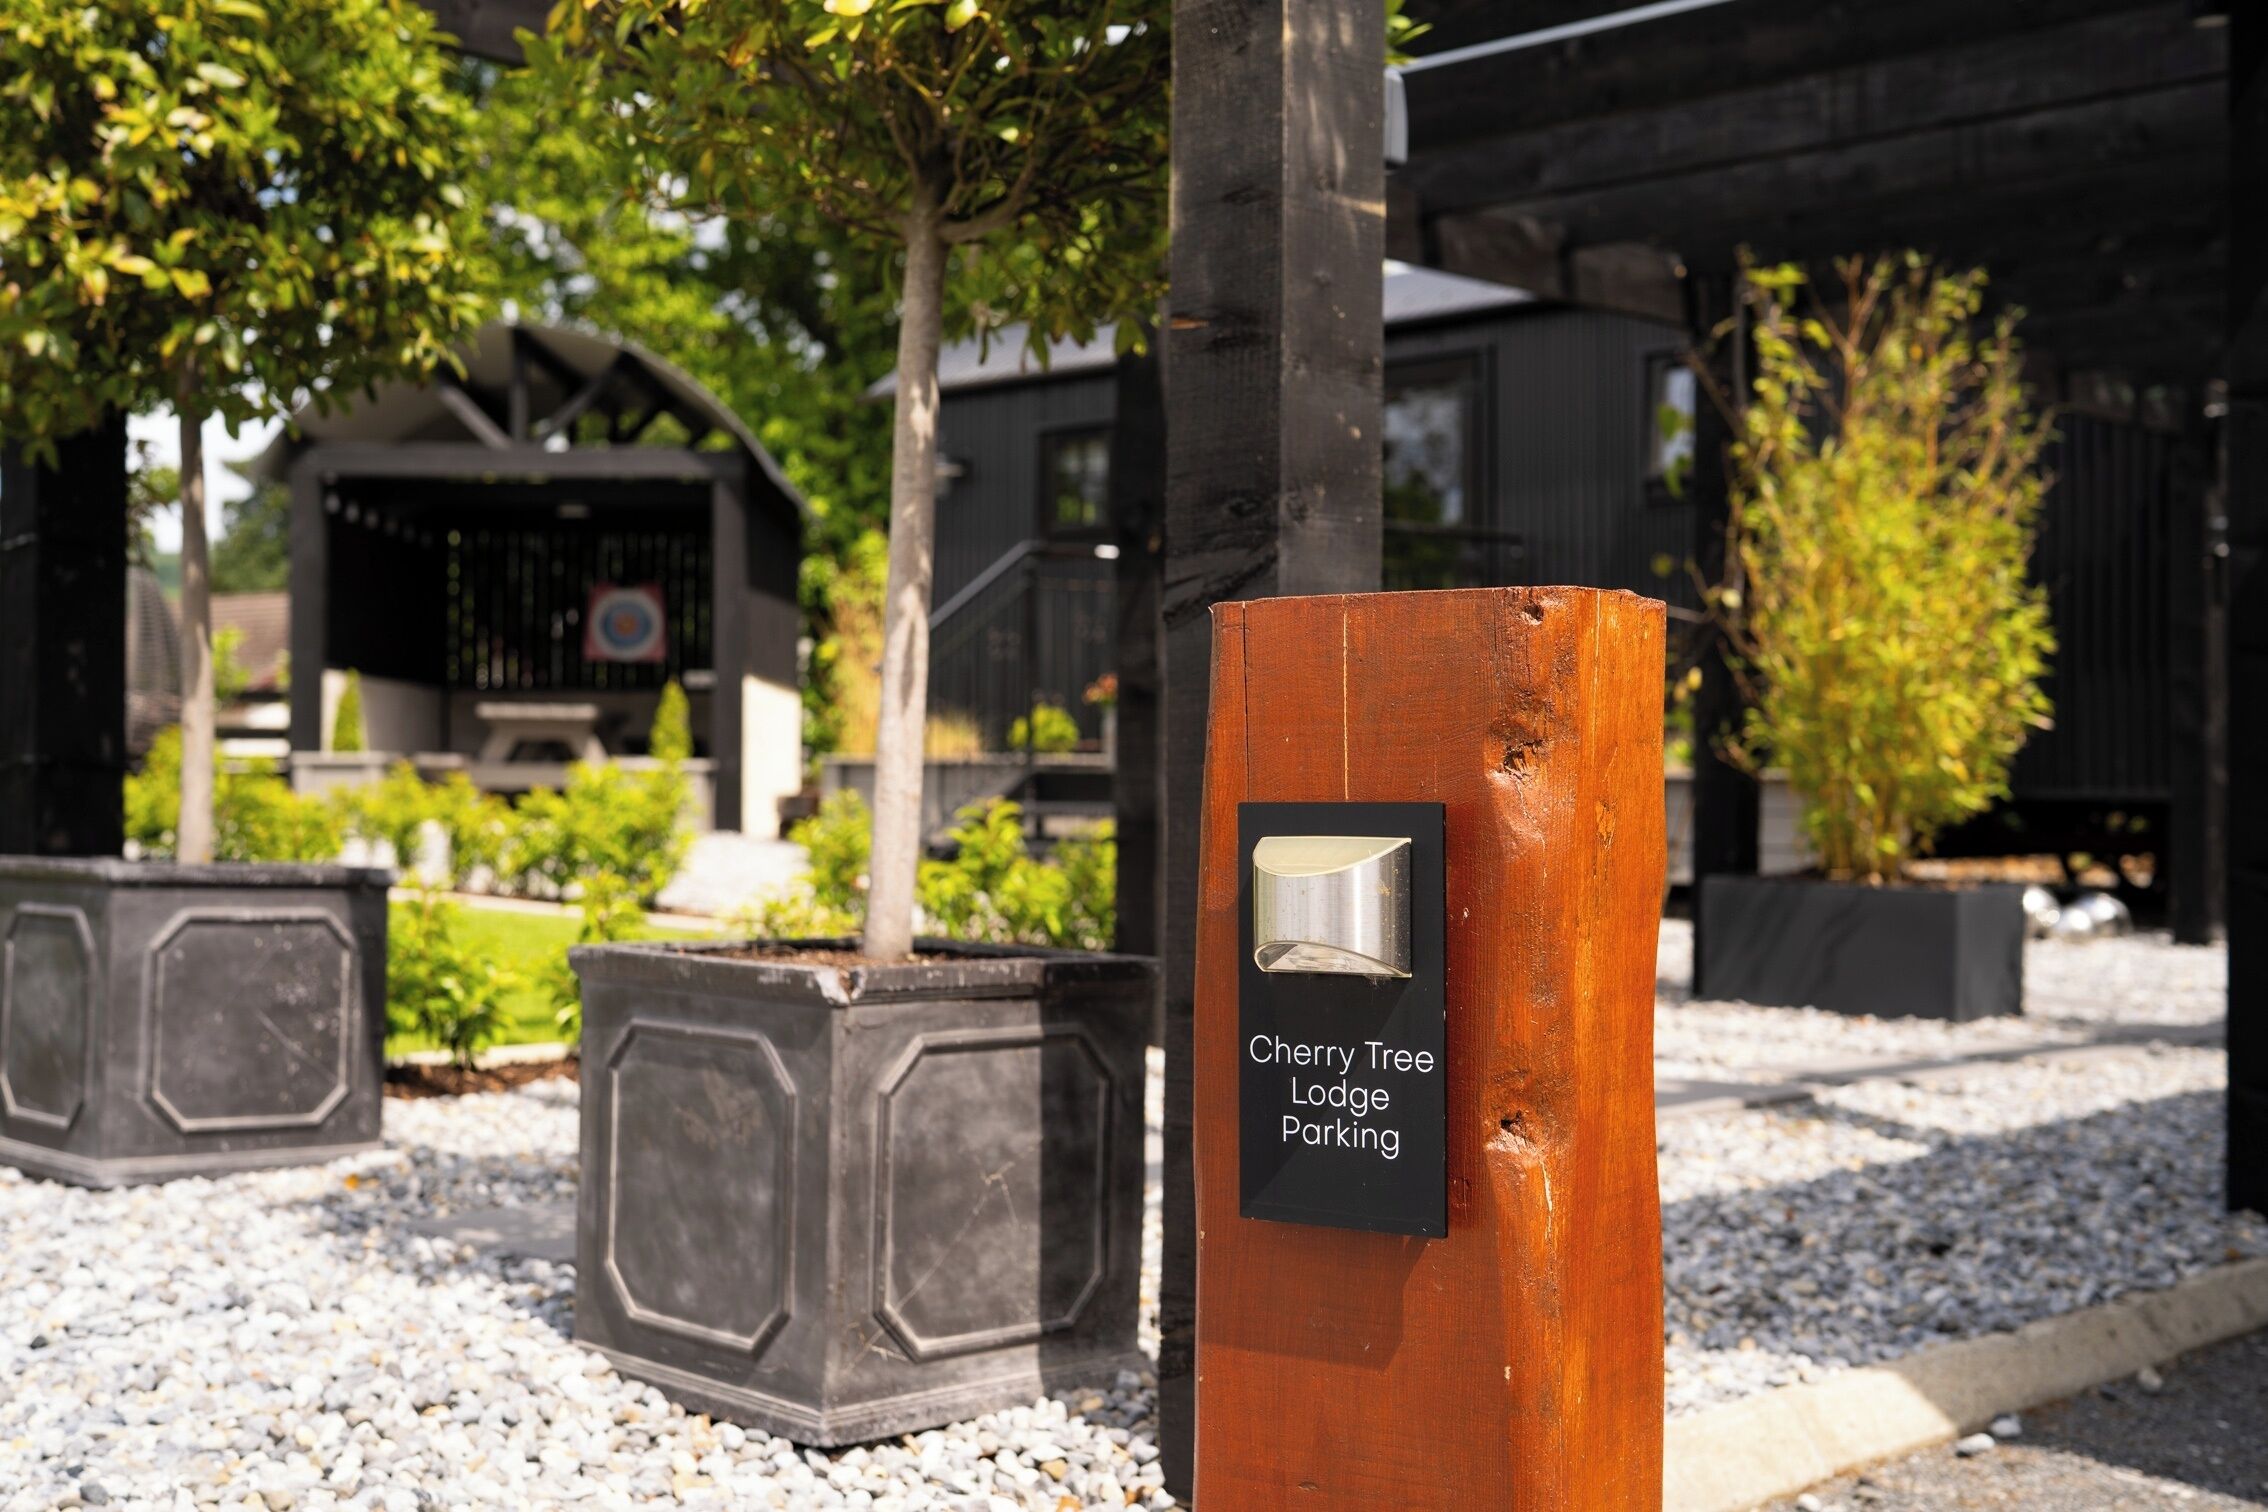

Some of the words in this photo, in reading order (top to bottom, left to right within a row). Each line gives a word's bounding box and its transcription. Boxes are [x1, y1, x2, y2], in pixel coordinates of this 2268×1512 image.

[1249, 1034, 1356, 1076] Cherry
[1364, 1041, 1435, 1073] Tree
[1292, 1076, 1390, 1118] Lodge
[1282, 1115, 1400, 1160] Parking
